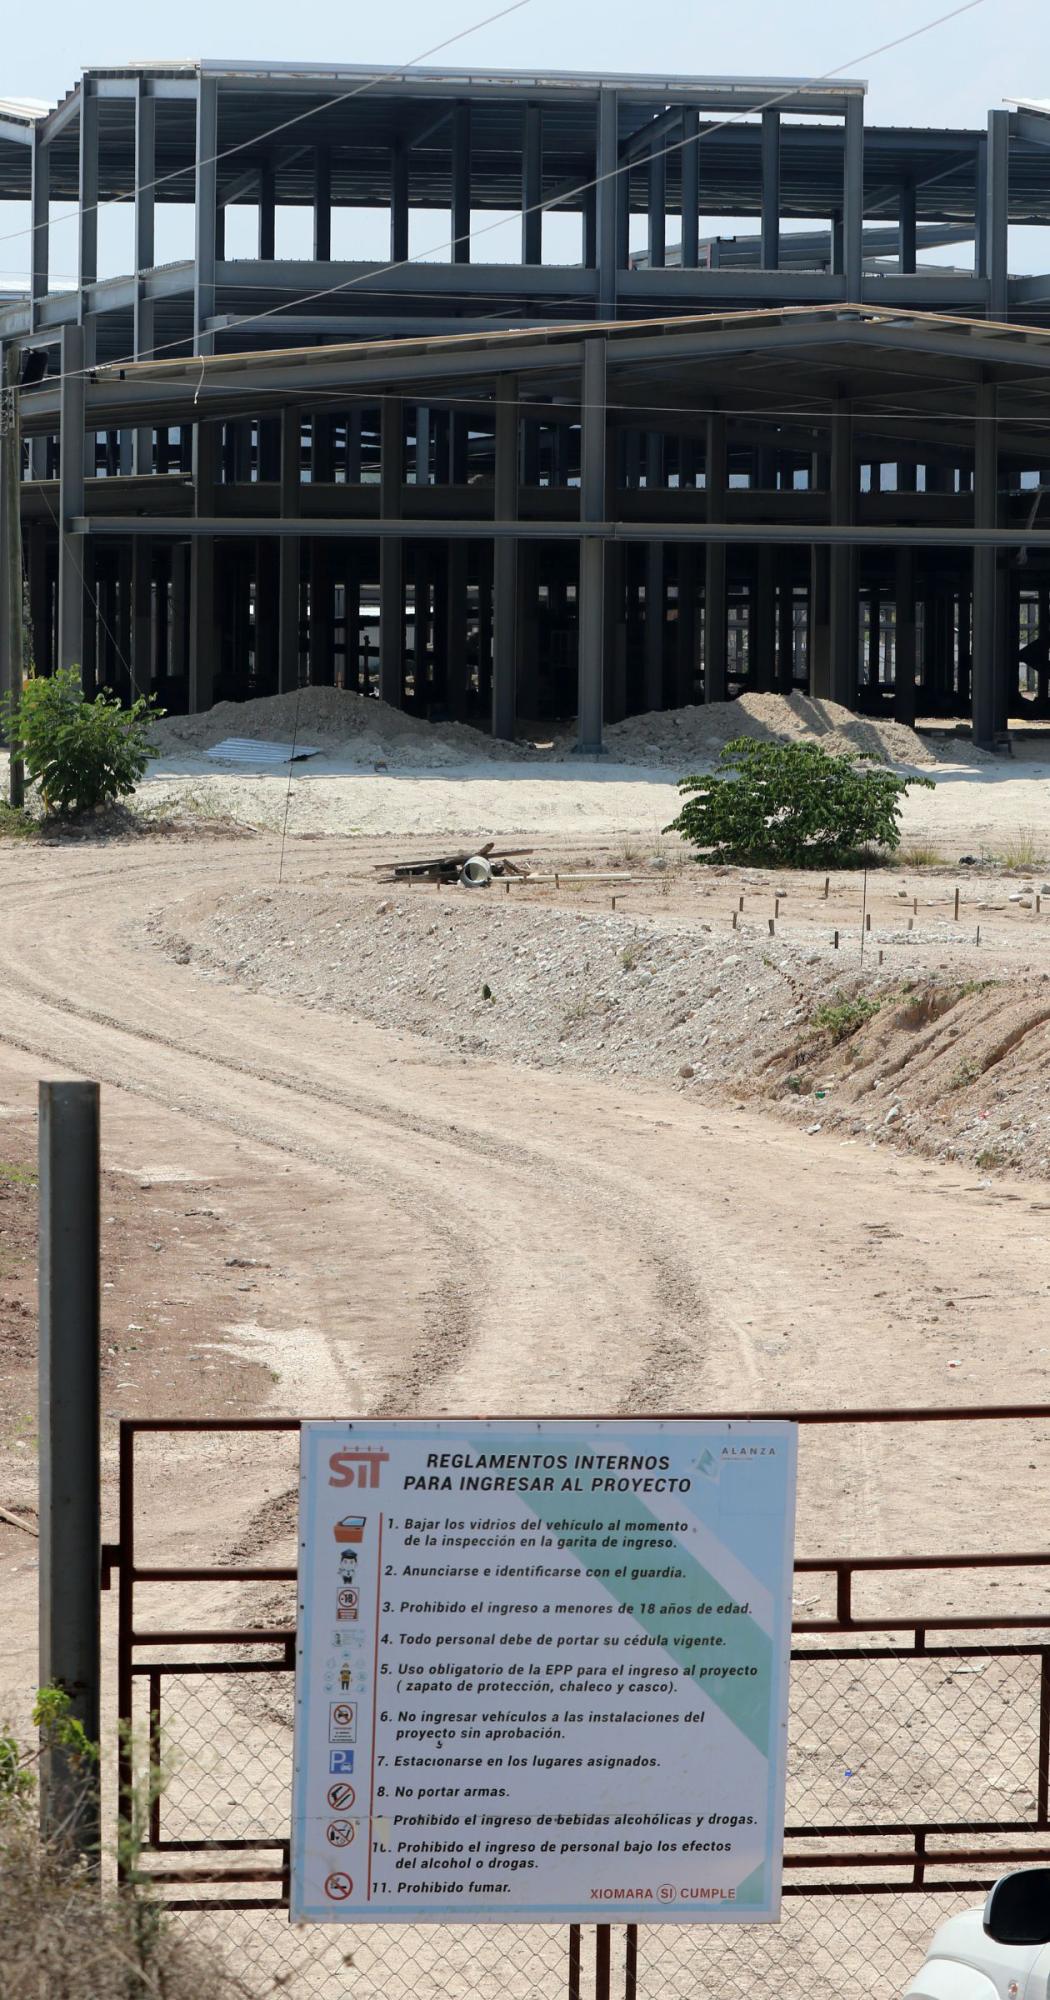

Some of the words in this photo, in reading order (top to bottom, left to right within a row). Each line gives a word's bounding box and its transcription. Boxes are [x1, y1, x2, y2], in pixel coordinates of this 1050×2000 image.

[722, 1447, 775, 1455] ALANZA
[426, 1453, 568, 1469] REGLAMENTOS
[574, 1455, 670, 1470] INTERNOS
[403, 1475, 452, 1491] PARA
[459, 1476, 555, 1491] INGRESAR
[560, 1477, 583, 1491] AL
[591, 1477, 691, 1493] PROYECTO
[388, 1518, 399, 1529] 1.
[404, 1518, 441, 1532] Bajar
[444, 1518, 465, 1530] los
[470, 1518, 516, 1530] vidrios
[520, 1518, 542, 1530] del
[546, 1519, 604, 1531] vehículo
[607, 1519, 621, 1531] al
[624, 1521, 688, 1532] momento
[404, 1534, 420, 1546] de
[425, 1534, 437, 1546] la
[441, 1534, 515, 1549] inspección
[520, 1538, 536, 1547] en
[540, 1535, 553, 1547] la
[557, 1535, 597, 1550] garita
[601, 1535, 618, 1548] de
[622, 1536, 677, 1550] ingreso.
[384, 1565, 397, 1576] 2.
[402, 1564, 479, 1576] Anunciarse
[483, 1568, 491, 1577] e
[495, 1565, 581, 1577] identificarse
[585, 1568, 610, 1578] con
[614, 1566, 627, 1577] el
[631, 1566, 686, 1580] guardia.
[382, 1601, 395, 1613] 3.
[400, 1601, 466, 1613] Prohibido
[470, 1601, 484, 1613] el
[487, 1601, 538, 1616] ingreso
[542, 1605, 550, 1613] a
[555, 1605, 613, 1614] menores
[618, 1602, 634, 1614] de
[640, 1603, 655, 1614] 18
[659, 1603, 692, 1614] años
[697, 1603, 713, 1614] de
[716, 1602, 752, 1614] edad.
[380, 1633, 393, 1645] 4.
[399, 1633, 432, 1645] Todo
[435, 1633, 496, 1647] personal
[499, 1633, 532, 1645] debe
[536, 1634, 553, 1645] de
[556, 1635, 600, 1648] portar
[603, 1637, 619, 1646] su
[624, 1634, 668, 1646] cédula
[673, 1635, 726, 1649] vigente.
[380, 1663, 392, 1675] 5.
[398, 1663, 424, 1675] Uso
[428, 1663, 504, 1678] obligatorio
[508, 1663, 524, 1675] de
[528, 1663, 541, 1675] la
[545, 1664, 573, 1675] EPP
[576, 1667, 607, 1678] para
[611, 1664, 624, 1676] el
[628, 1664, 679, 1679] ingreso
[683, 1664, 696, 1676] al
[699, 1665, 758, 1679] proyecto
[405, 1681, 453, 1694] zapato
[457, 1679, 473, 1692] de
[477, 1680, 554, 1694] protección,
[559, 1680, 612, 1692] chaleco
[616, 1683, 625, 1695] y
[628, 1681, 677, 1695] casco).
[380, 1711, 392, 1722] 6.
[397, 1711, 416, 1722] No
[420, 1710, 478, 1725] ingresar
[482, 1710, 547, 1723] vehículos
[551, 1713, 559, 1722] a
[564, 1710, 584, 1723] las
[588, 1711, 680, 1723] instalaciones
[684, 1711, 705, 1723] del
[395, 1728, 456, 1741] proyecto
[460, 1726, 481, 1739] sin
[485, 1727, 565, 1741] aprobación.
[377, 1755, 389, 1767] 7.
[487, 1758, 503, 1767] en
[507, 1755, 528, 1767] los
[532, 1755, 583, 1769] lugares
[586, 1755, 660, 1769] asignados.
[376, 1786, 389, 1797] 8.
[395, 1786, 414, 1797] No
[417, 1786, 460, 1800] portar
[464, 1788, 510, 1797] armas.
[393, 1814, 460, 1826] Prohibido
[464, 1814, 477, 1826] el
[481, 1814, 532, 1828] ingreso
[536, 1814, 553, 1825] de
[557, 1813, 610, 1825] bebidas
[614, 1813, 692, 1825] alcohólicas
[695, 1816, 705, 1828] y
[708, 1813, 757, 1828] drogas.
[397, 1841, 464, 1853] Prohibido
[468, 1841, 481, 1853] el
[485, 1841, 536, 1855] ingreso
[540, 1840, 556, 1852] de
[560, 1840, 620, 1855] personal
[623, 1840, 653, 1855] bajo
[657, 1840, 677, 1852] los
[681, 1840, 732, 1852] efectos
[395, 1857, 417, 1869] del
[420, 1857, 472, 1869] alcohol
[475, 1860, 484, 1869] o
[488, 1857, 539, 1871] drogas.
[372, 1882, 392, 1893] 11.
[397, 1881, 464, 1893] Prohibido
[468, 1881, 511, 1893] fumar.
[590, 1888, 653, 1900] XIOMARA
[680, 1888, 736, 1899] CUMPLE
